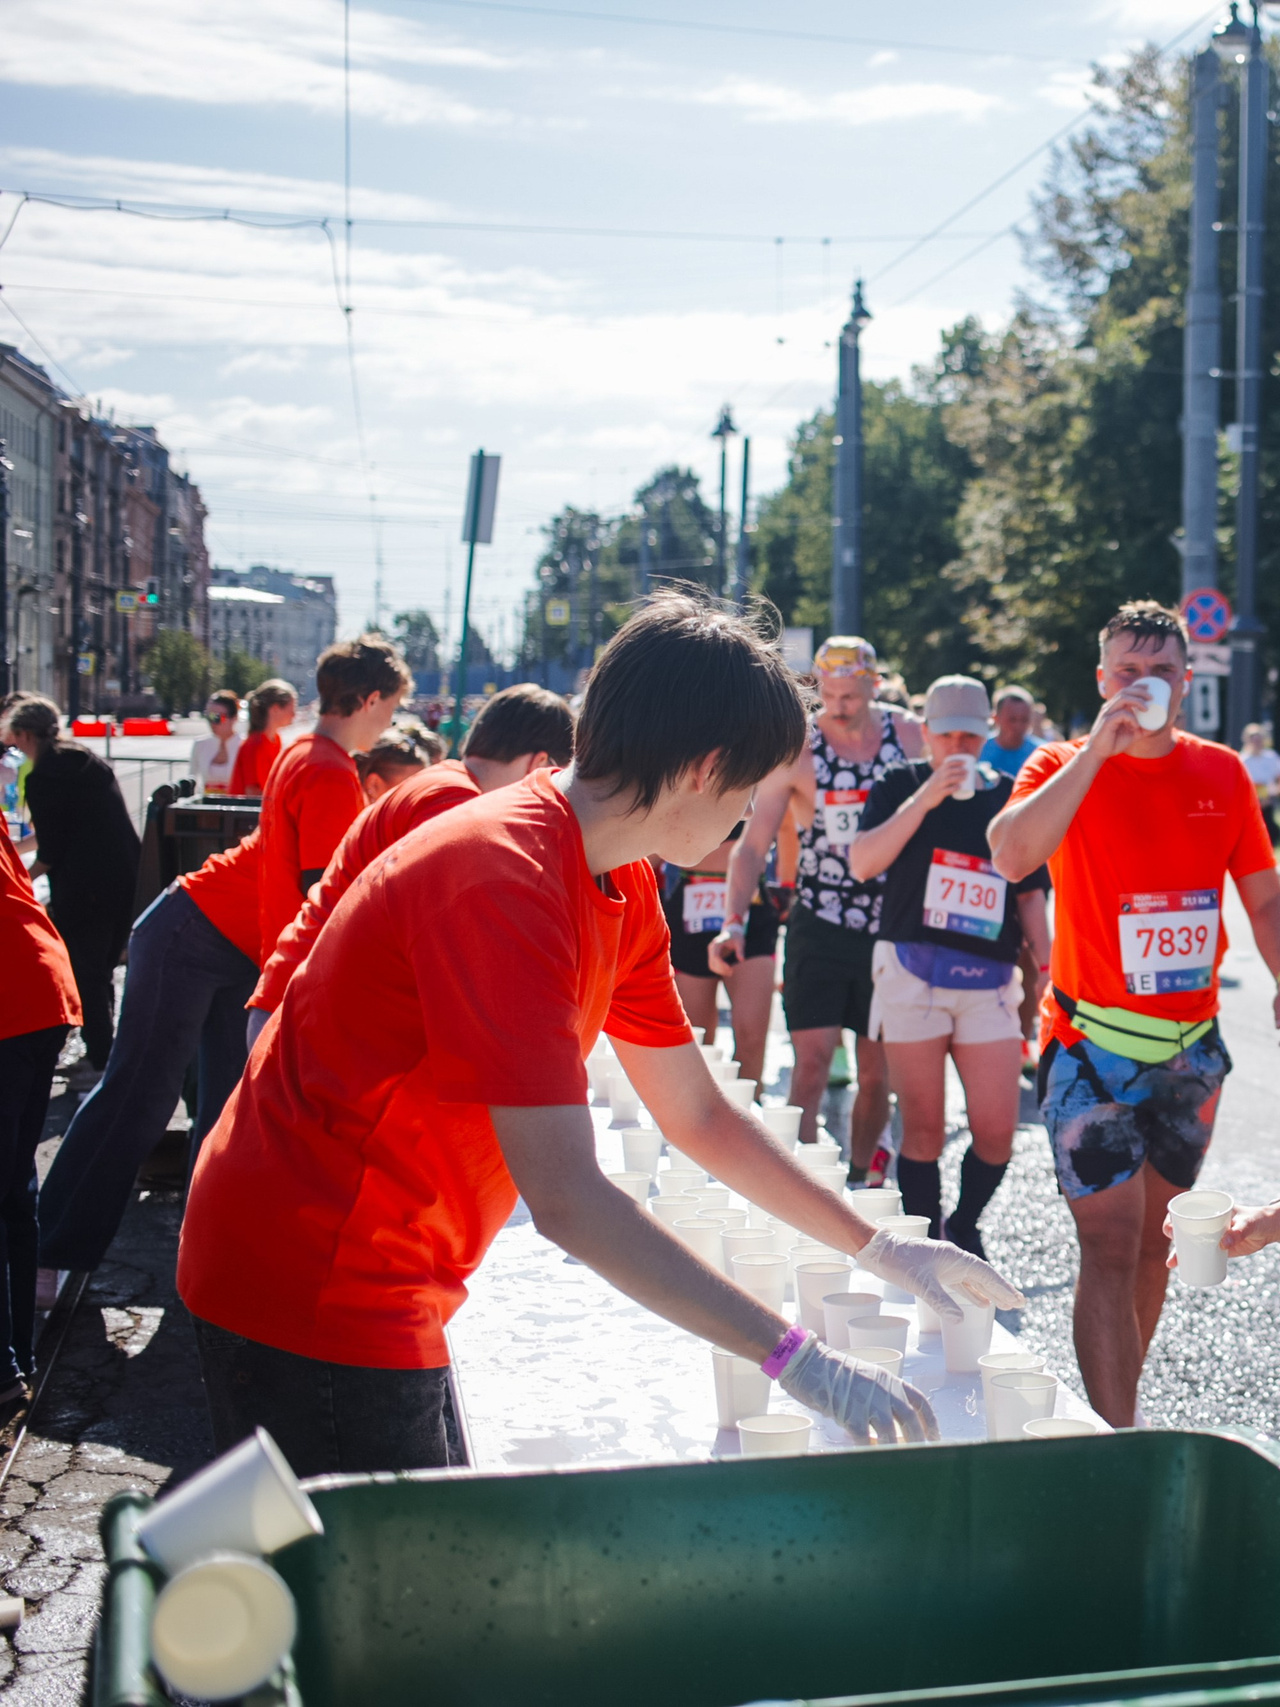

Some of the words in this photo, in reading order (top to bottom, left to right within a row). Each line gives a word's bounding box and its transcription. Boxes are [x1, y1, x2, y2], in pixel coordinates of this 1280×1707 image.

[940, 877, 998, 911] 7130
[933, 911, 943, 924] D
[1136, 925, 1209, 959] 7839
[1140, 974, 1152, 991] E
